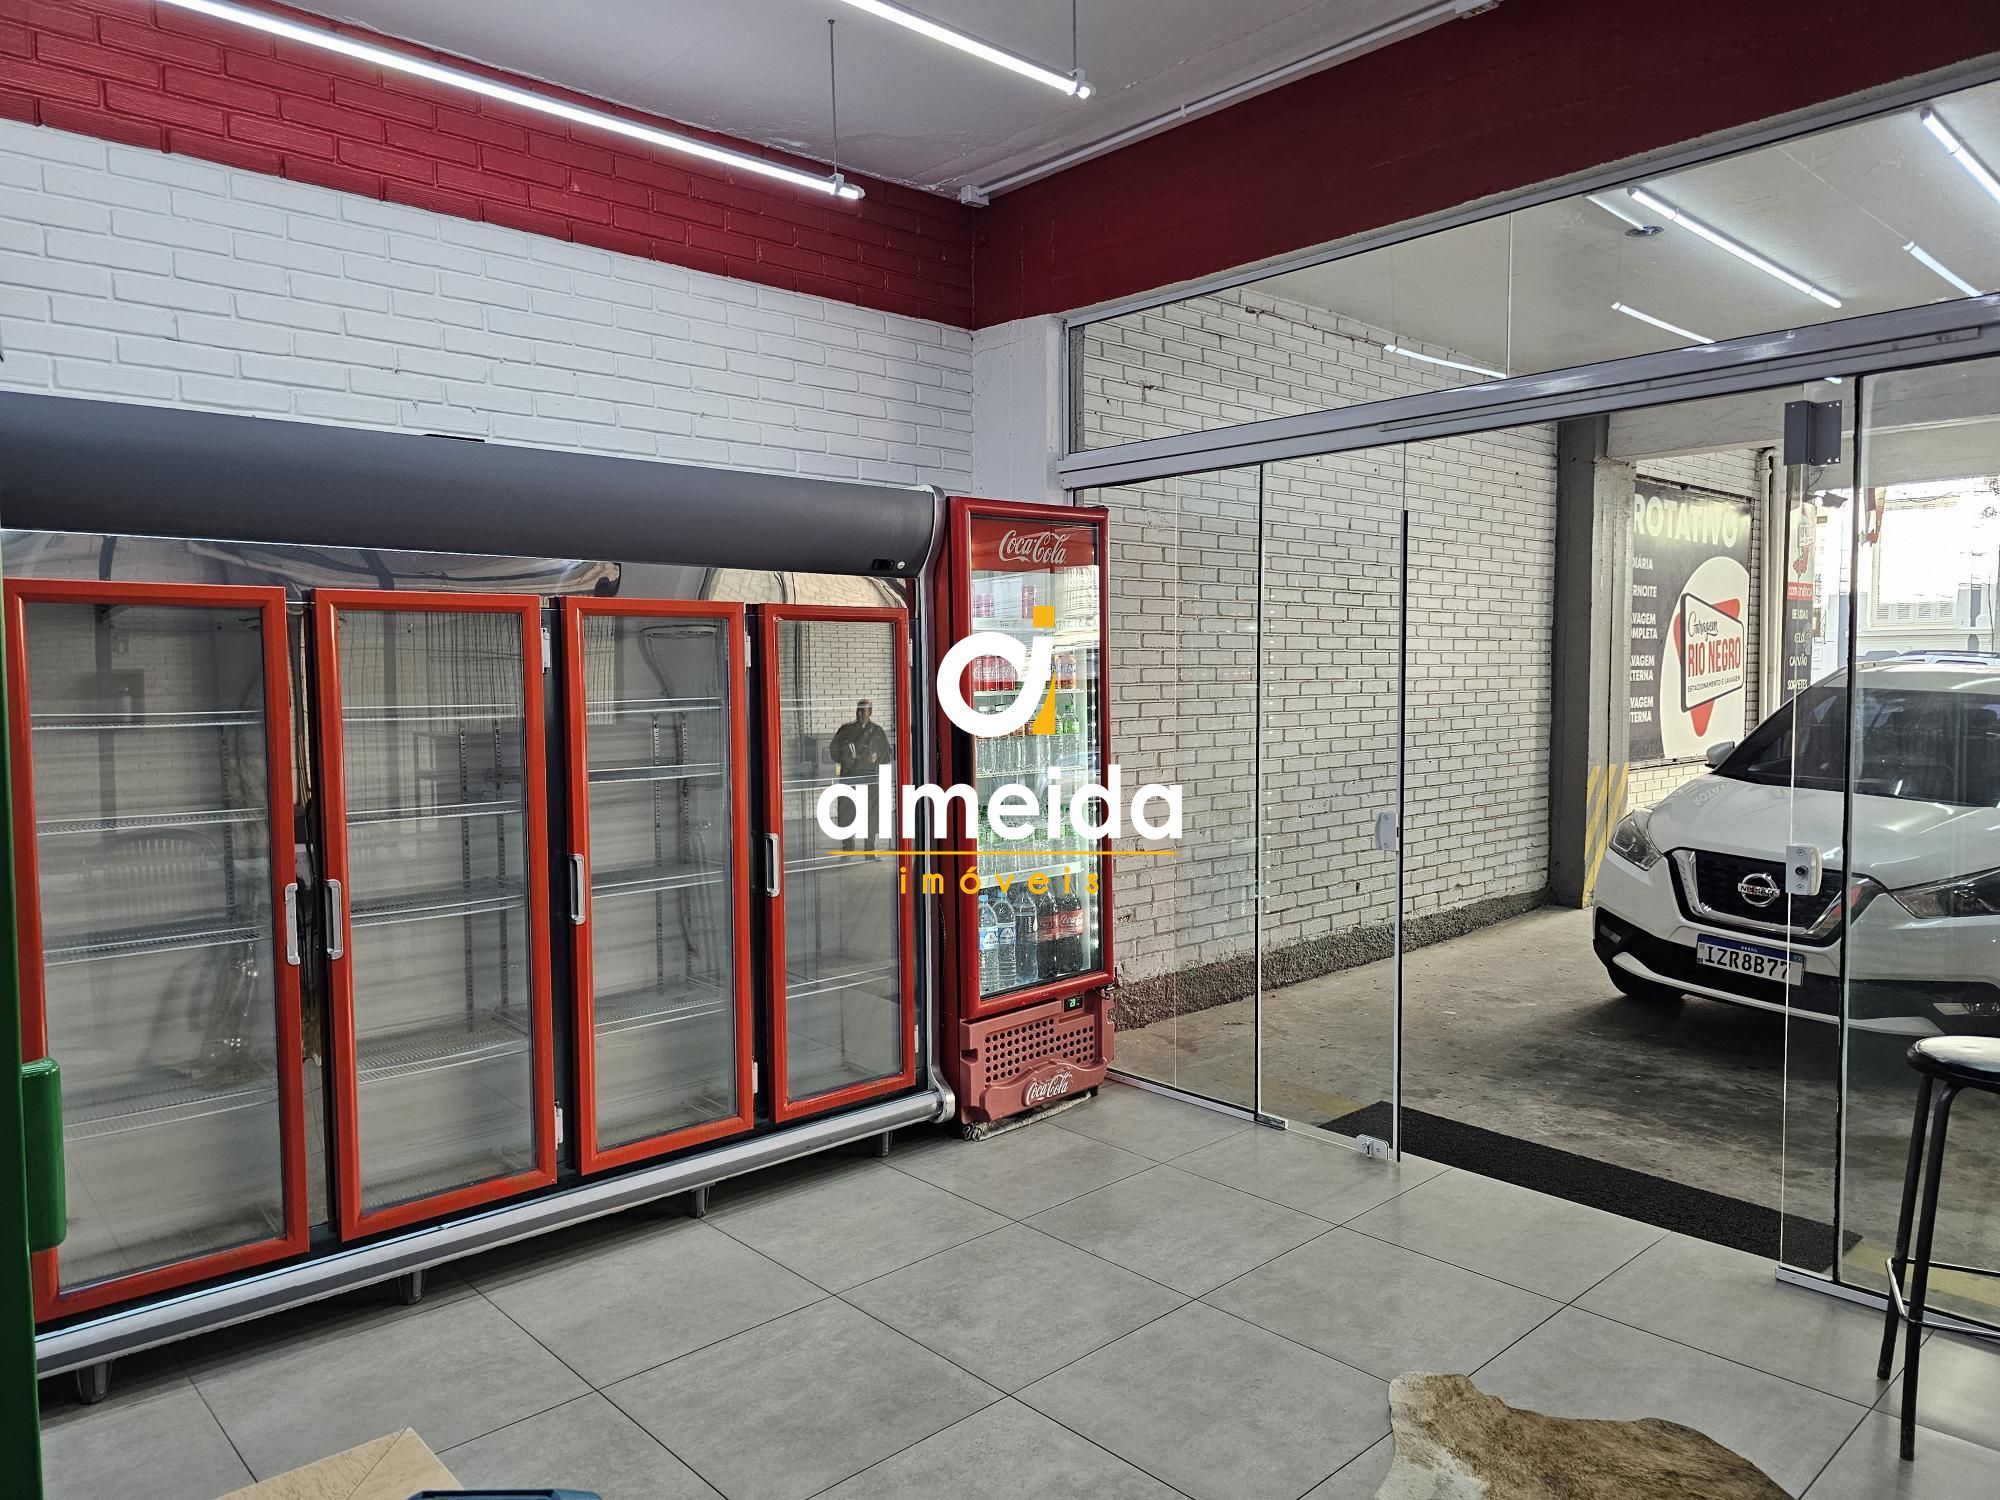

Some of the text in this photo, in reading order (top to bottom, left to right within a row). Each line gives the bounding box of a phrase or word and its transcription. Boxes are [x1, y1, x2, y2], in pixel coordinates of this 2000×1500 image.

[1634, 494, 1737, 548] ROTATIVO
[1631, 627, 1658, 639] MPLETA
[1688, 637, 1741, 677] RIO NEGRO
[1629, 696, 1654, 709] VAGEM
[1629, 711, 1652, 723] TERNA
[1705, 946, 1790, 979] IZR8B77
